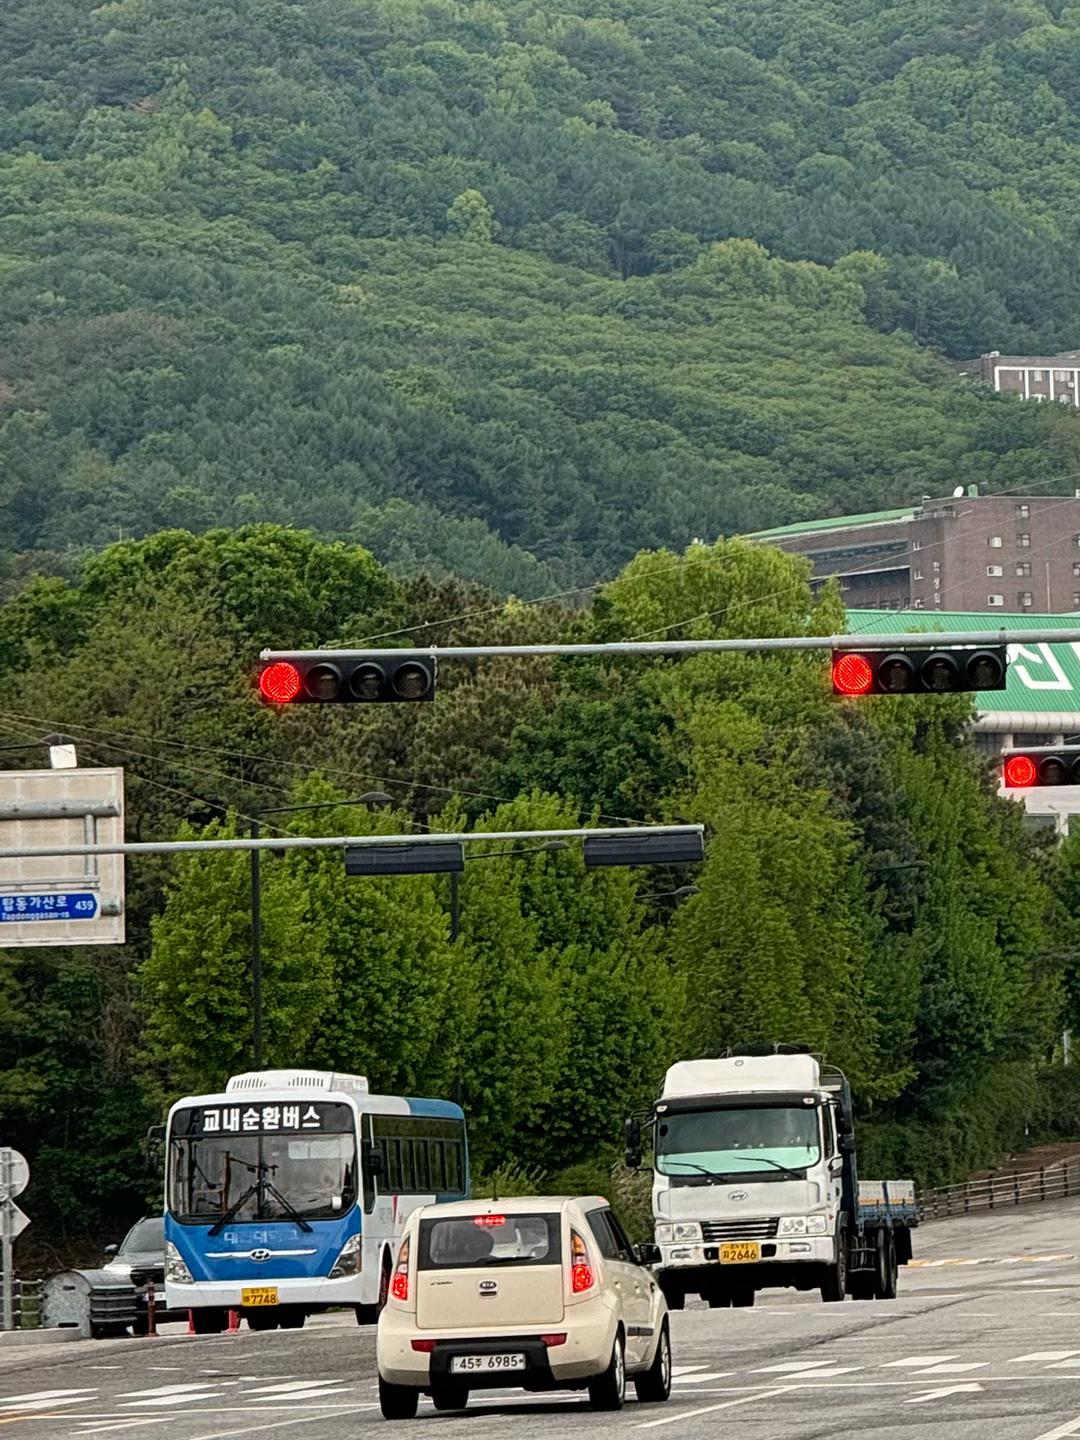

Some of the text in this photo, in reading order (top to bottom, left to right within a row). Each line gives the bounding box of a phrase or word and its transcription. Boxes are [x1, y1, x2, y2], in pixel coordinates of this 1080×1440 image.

[2, 896, 94, 912] 탑동가산로 439
[203, 1106, 320, 1131] 교내순환버스
[488, 1355, 518, 1369] 6985
